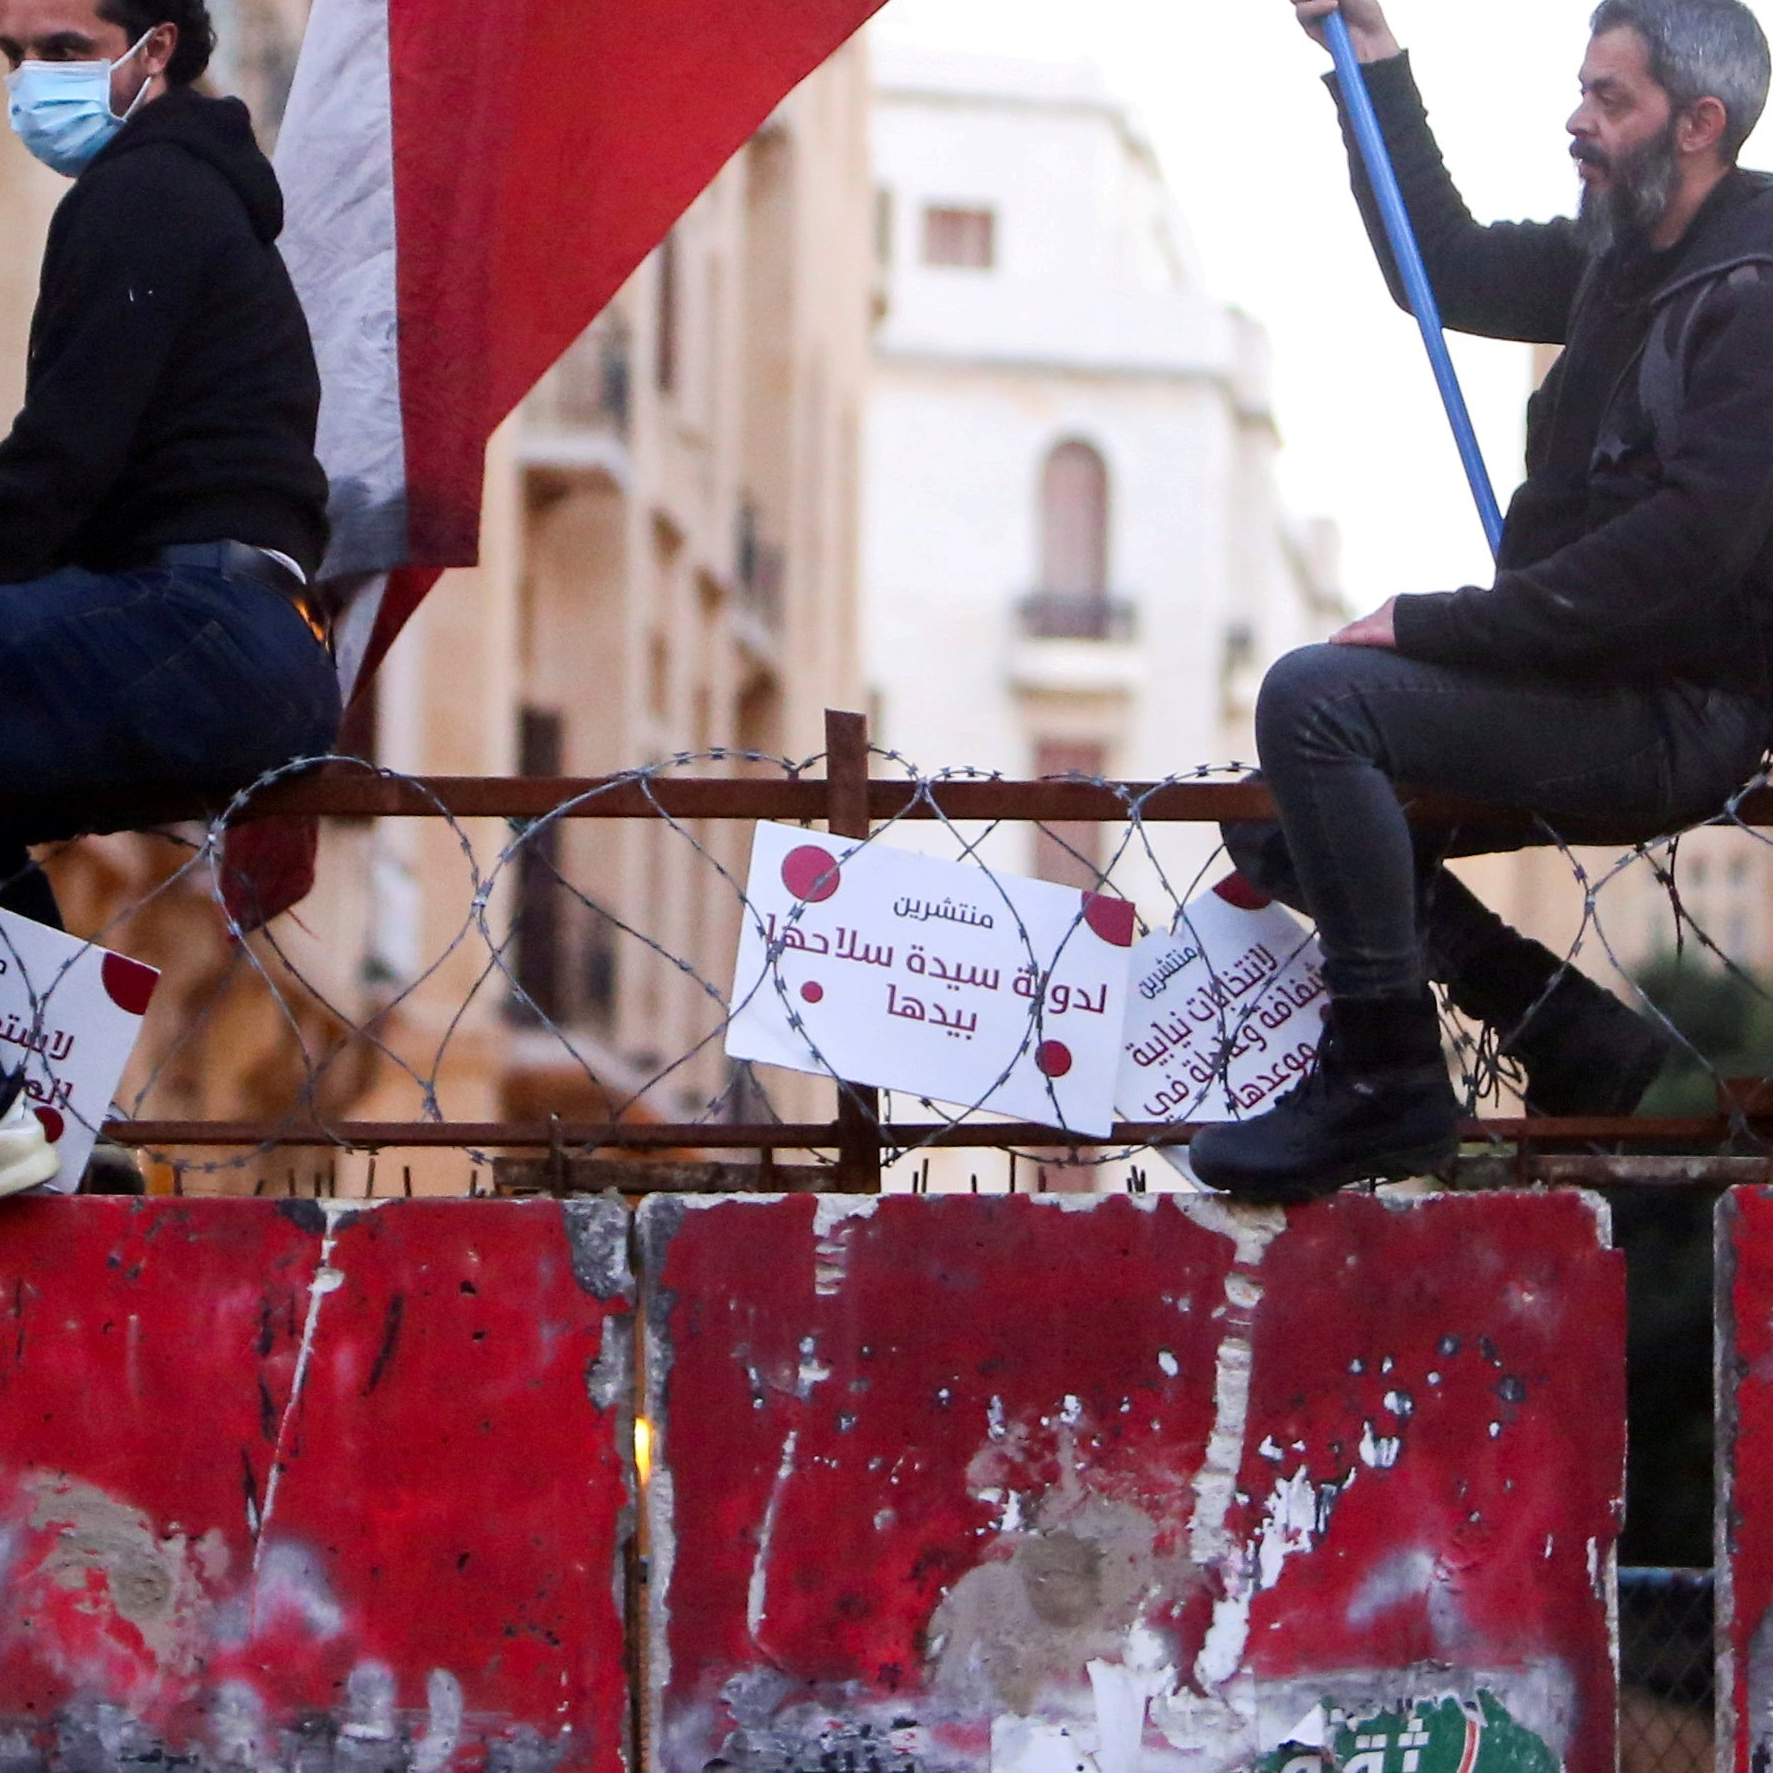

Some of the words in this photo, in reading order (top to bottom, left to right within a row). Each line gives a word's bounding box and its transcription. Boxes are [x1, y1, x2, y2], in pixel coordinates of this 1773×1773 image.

[893, 894, 994, 928] منتشرين
[766, 913, 894, 967] سلاحها
[906, 944, 1000, 991] سيدة
[1012, 966, 1107, 1014] لدولة
[1139, 947, 1197, 999] منتشرين
[1186, 943, 1278, 1022] لانتخابات
[887, 984, 978, 1040] بيدها
[1125, 1011, 1193, 1067] نيابية
[1143, 1074, 1190, 1122] في
[1224, 1042, 1318, 1110] موعدها
